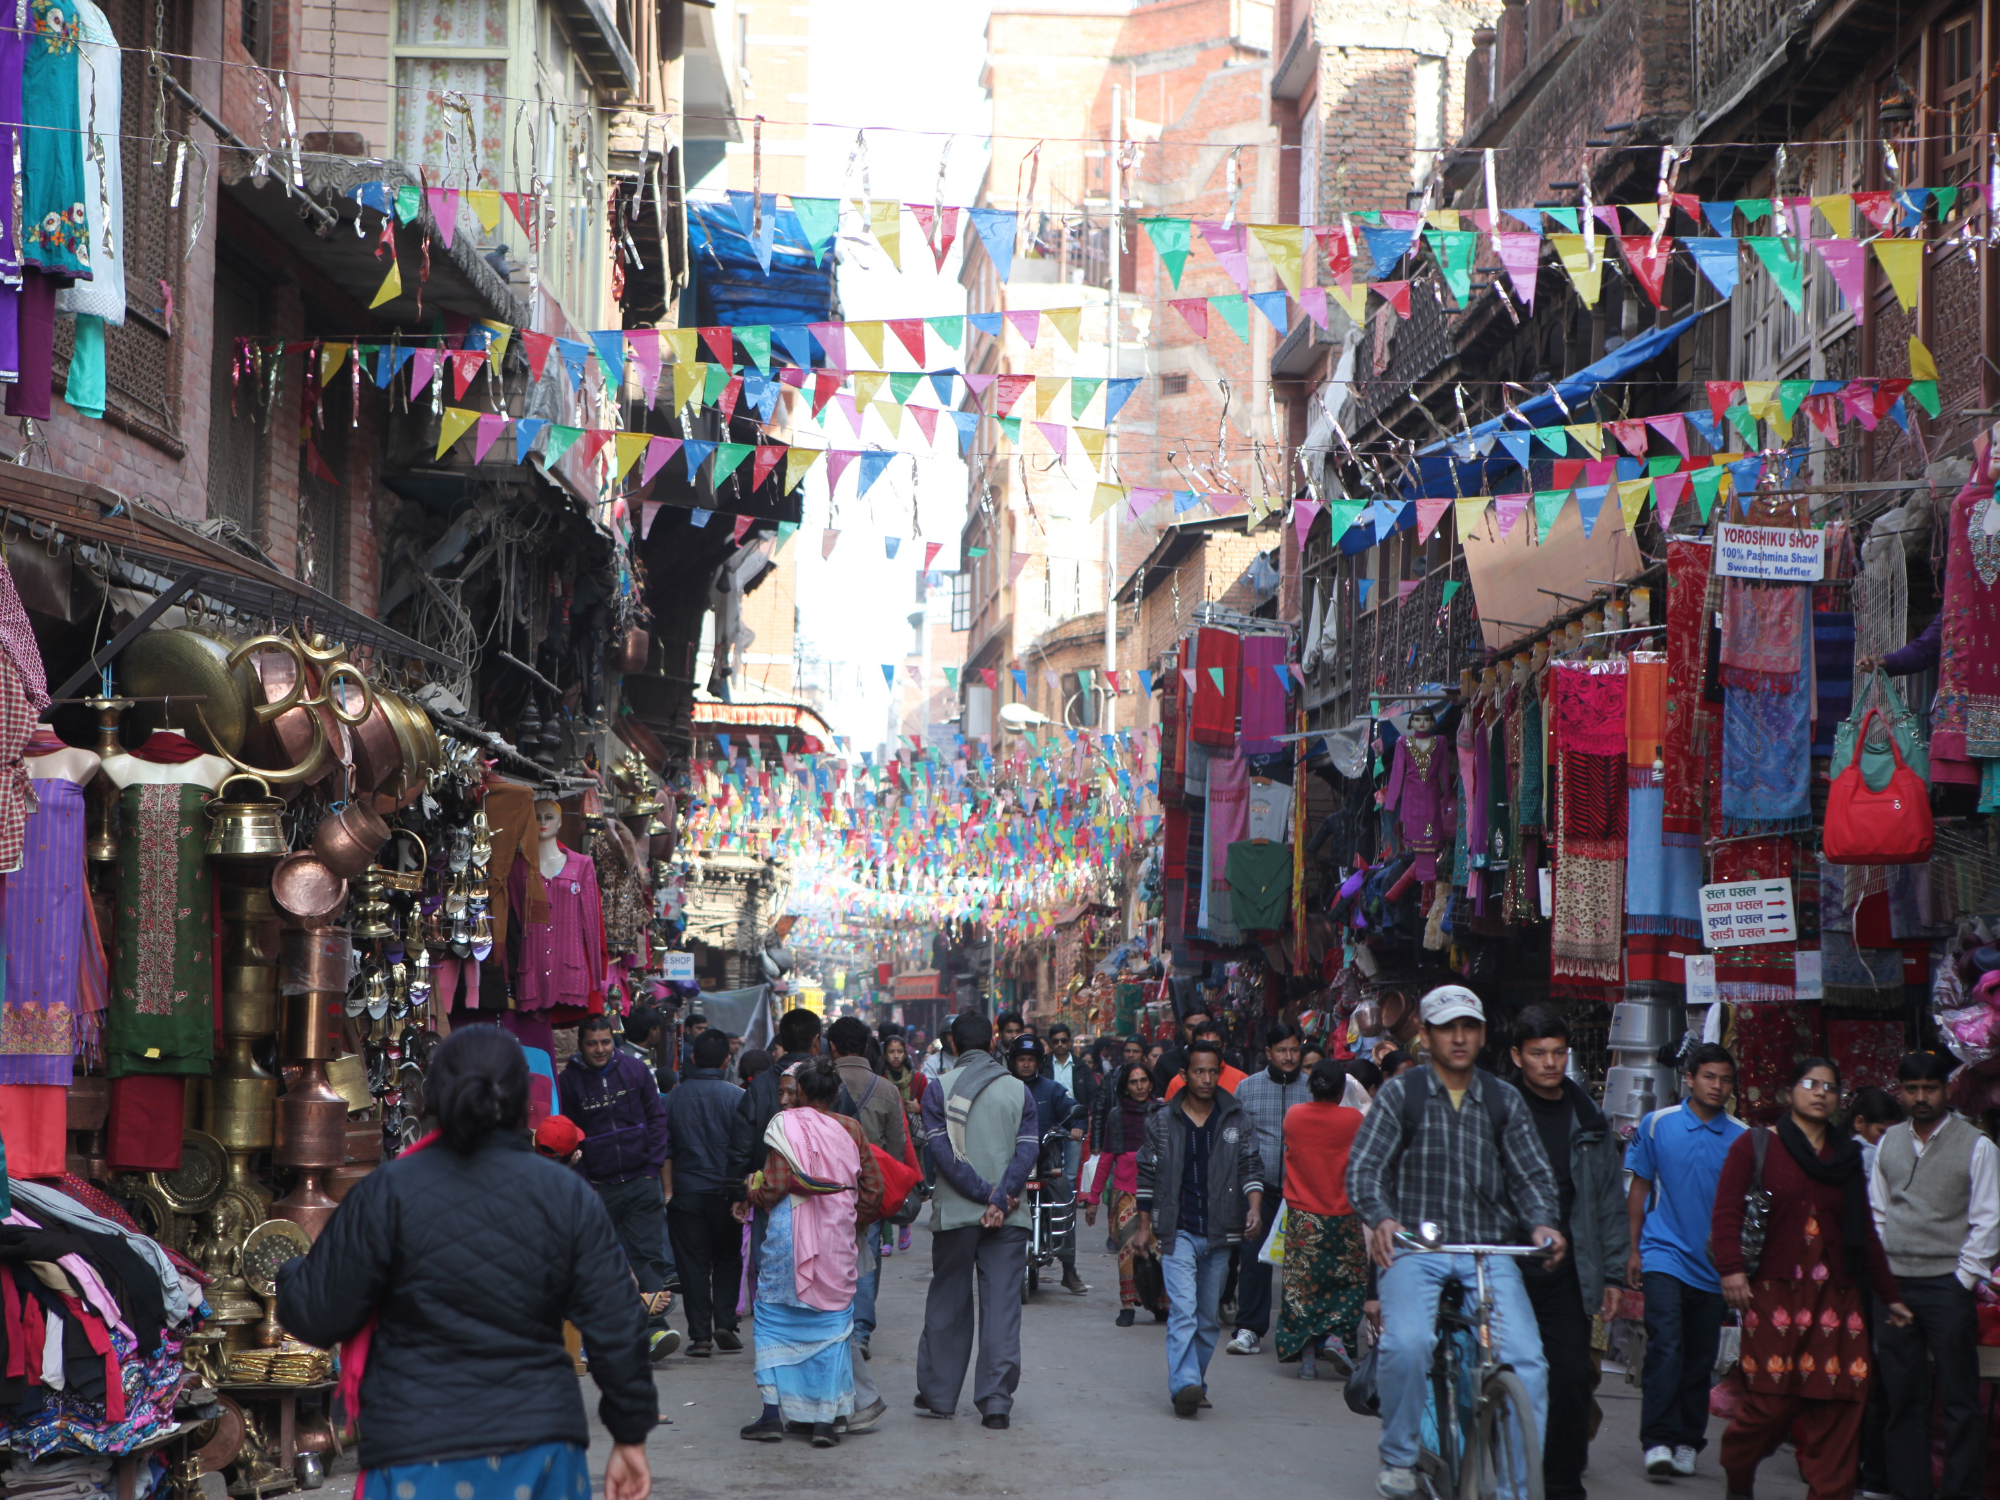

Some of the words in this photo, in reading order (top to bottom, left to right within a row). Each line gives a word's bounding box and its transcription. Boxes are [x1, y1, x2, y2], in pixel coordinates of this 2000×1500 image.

[1724, 527, 1786, 547] YOROSHIKU
[1789, 534, 1819, 549] SHOP
[1722, 547, 1744, 559] 100%
[1747, 549, 1788, 563] Pashmina
[1791, 552, 1818, 564] Shawl
[1727, 562, 1771, 576] Sweater,
[1774, 566, 1811, 576] Muffler
[1705, 889, 1725, 899] सल
[1729, 887, 1757, 897] पसल
[1706, 902, 1732, 912] ब्याग
[1735, 900, 1763, 910] पसल
[1735, 914, 1763, 924] पसल
[1738, 928, 1765, 938] पसल
[670, 956, 691, 964] SHOP
